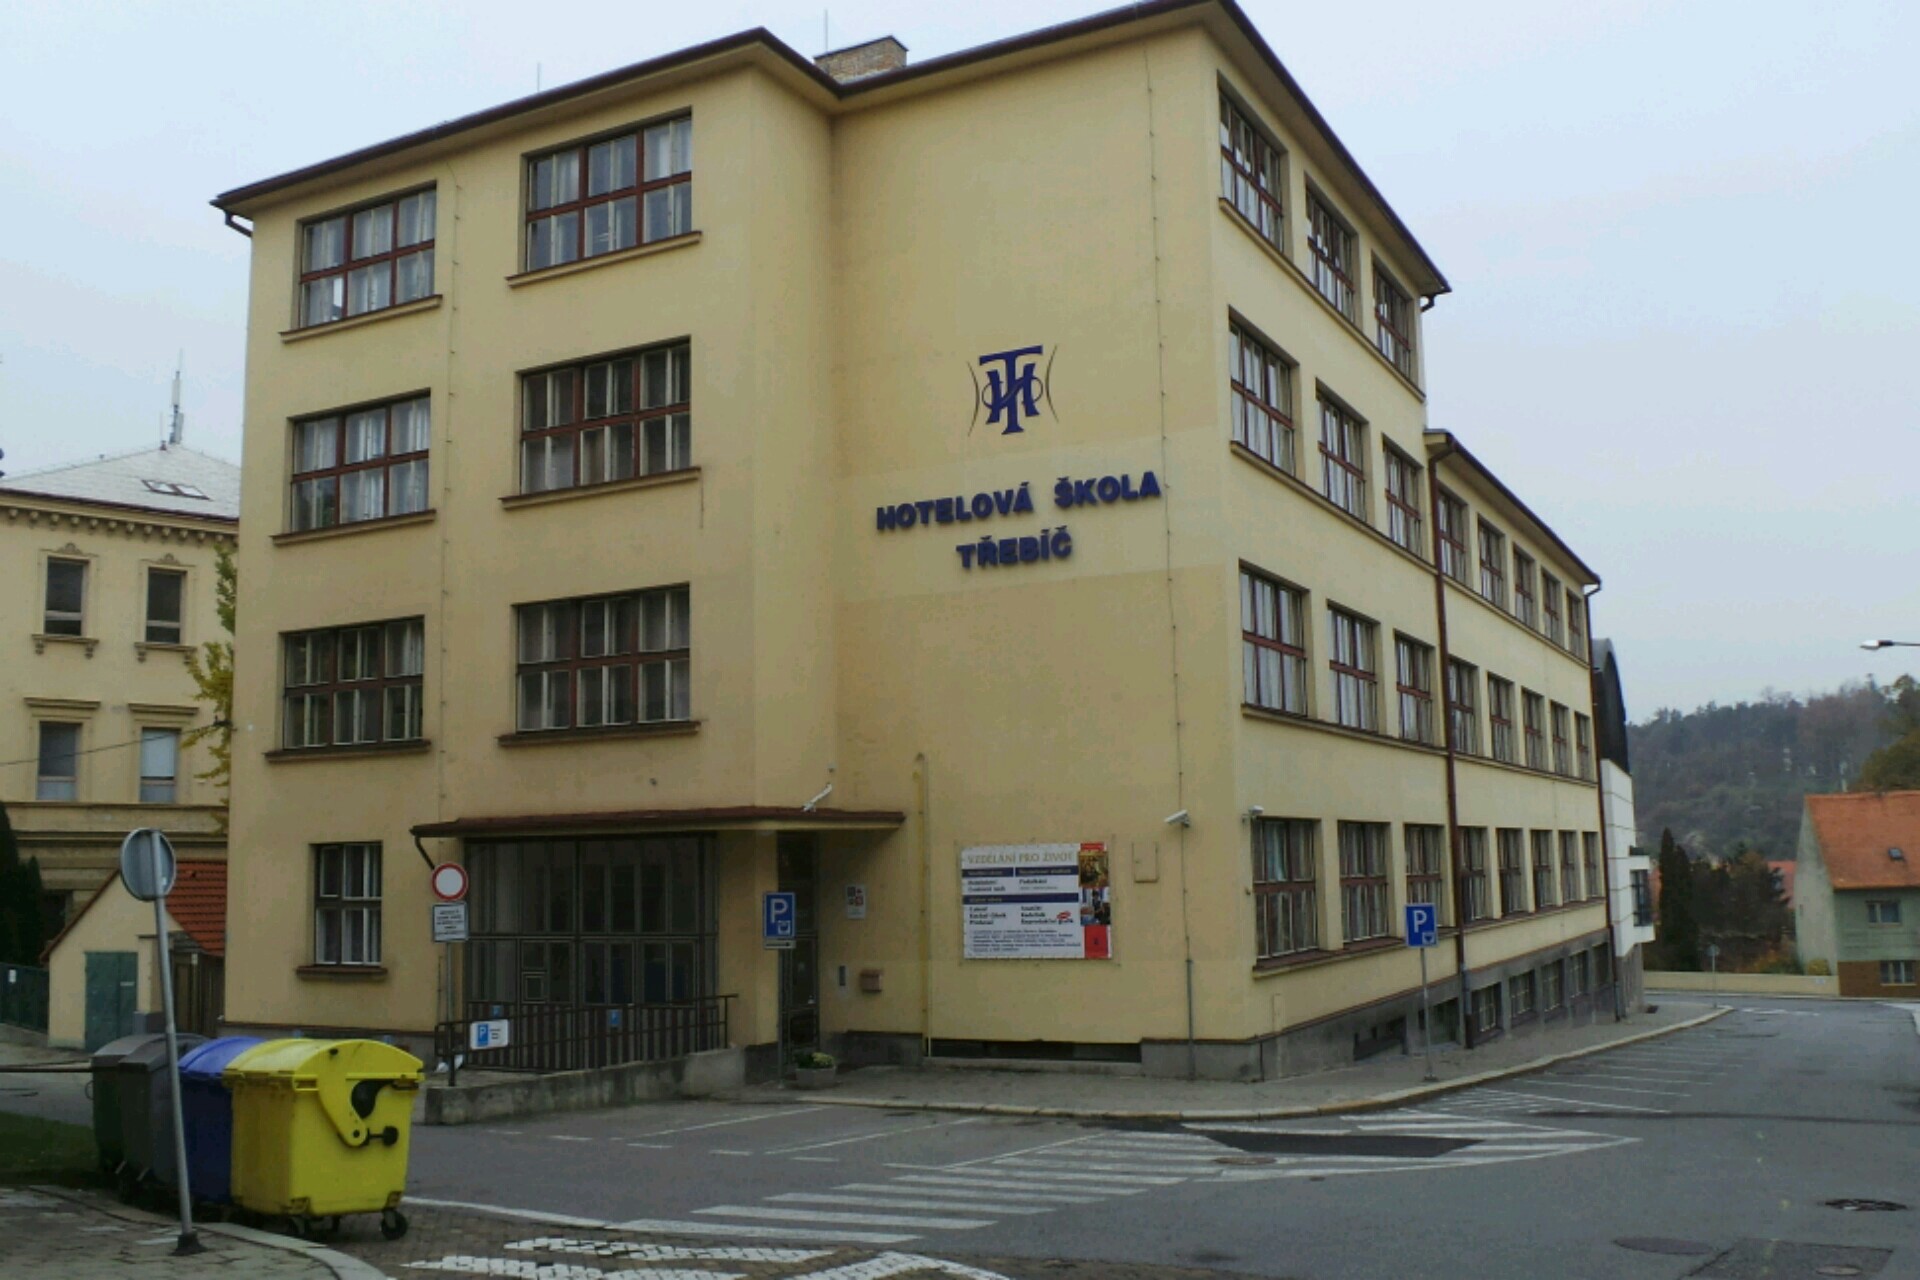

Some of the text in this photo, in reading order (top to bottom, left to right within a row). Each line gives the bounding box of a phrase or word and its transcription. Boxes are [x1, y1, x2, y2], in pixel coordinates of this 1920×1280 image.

[876, 471, 1161, 530] HOTELOVÁ ŠKOLA
[956, 525, 1073, 569] TŘEBÍČ
[1019, 853, 1040, 863] PRO
[770, 898, 788, 923] P
[1413, 910, 1427, 933] P
[479, 1026, 487, 1041] P
